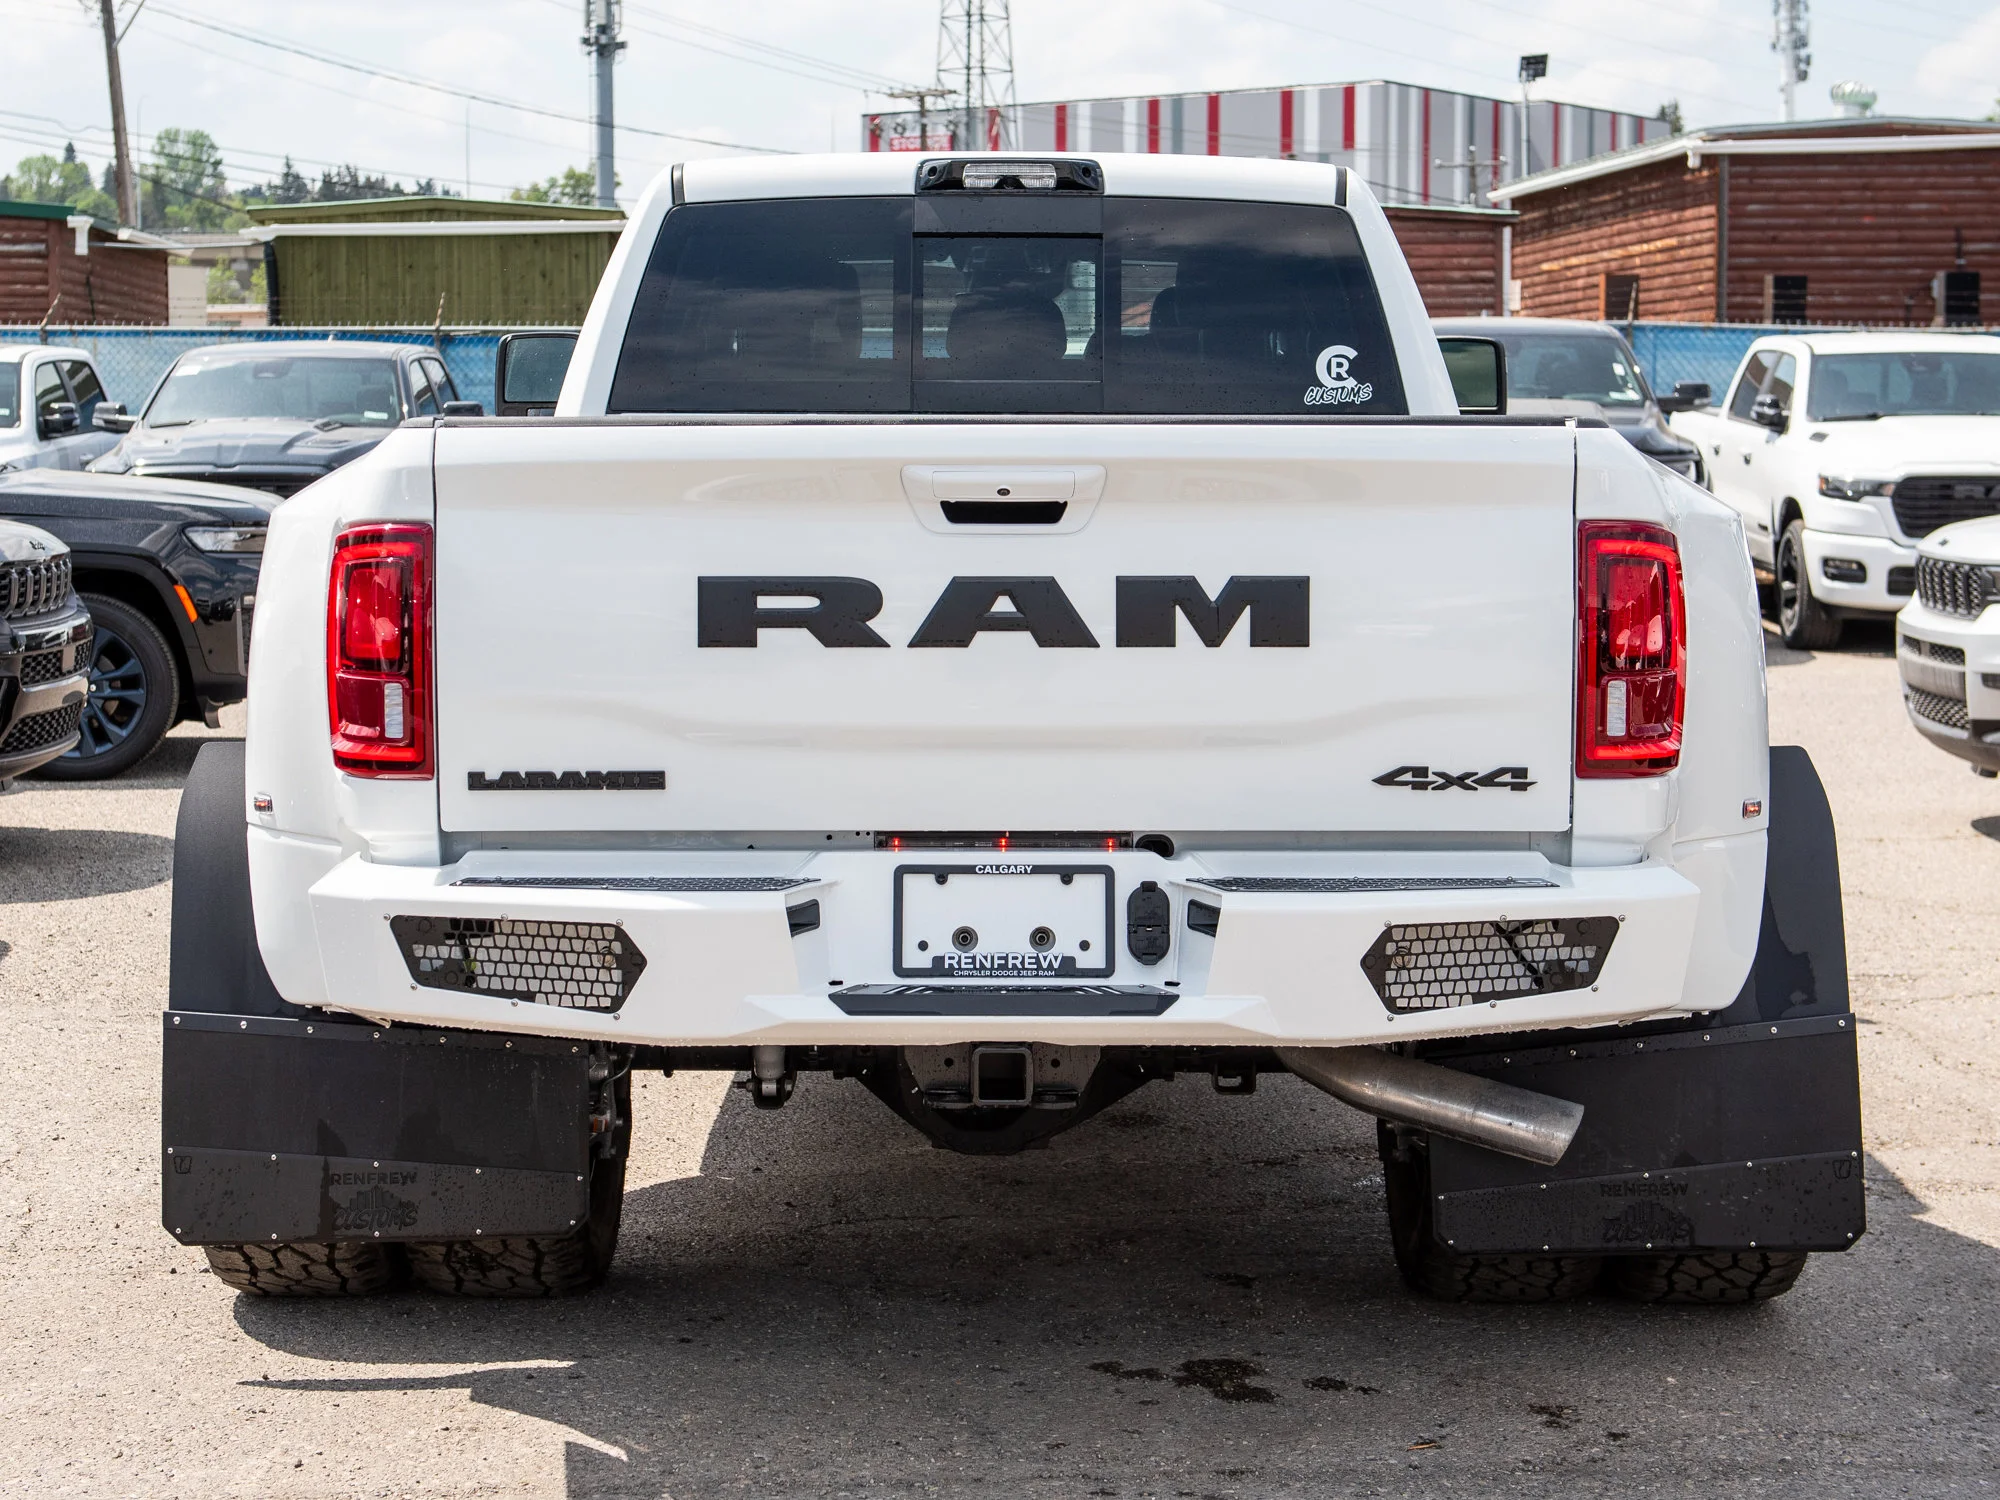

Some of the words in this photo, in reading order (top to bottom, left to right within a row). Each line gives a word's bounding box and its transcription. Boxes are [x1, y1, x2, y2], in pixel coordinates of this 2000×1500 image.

[1304, 383, 1373, 405] CUSTOMS
[698, 576, 1310, 648] RAM
[975, 865, 1033, 874] CALGARY
[944, 952, 1063, 969] RENFREW
[331, 1172, 417, 1185] RENFREW
[1600, 1182, 1688, 1197] RENFREW
[332, 1207, 418, 1231] CUSTOMS
